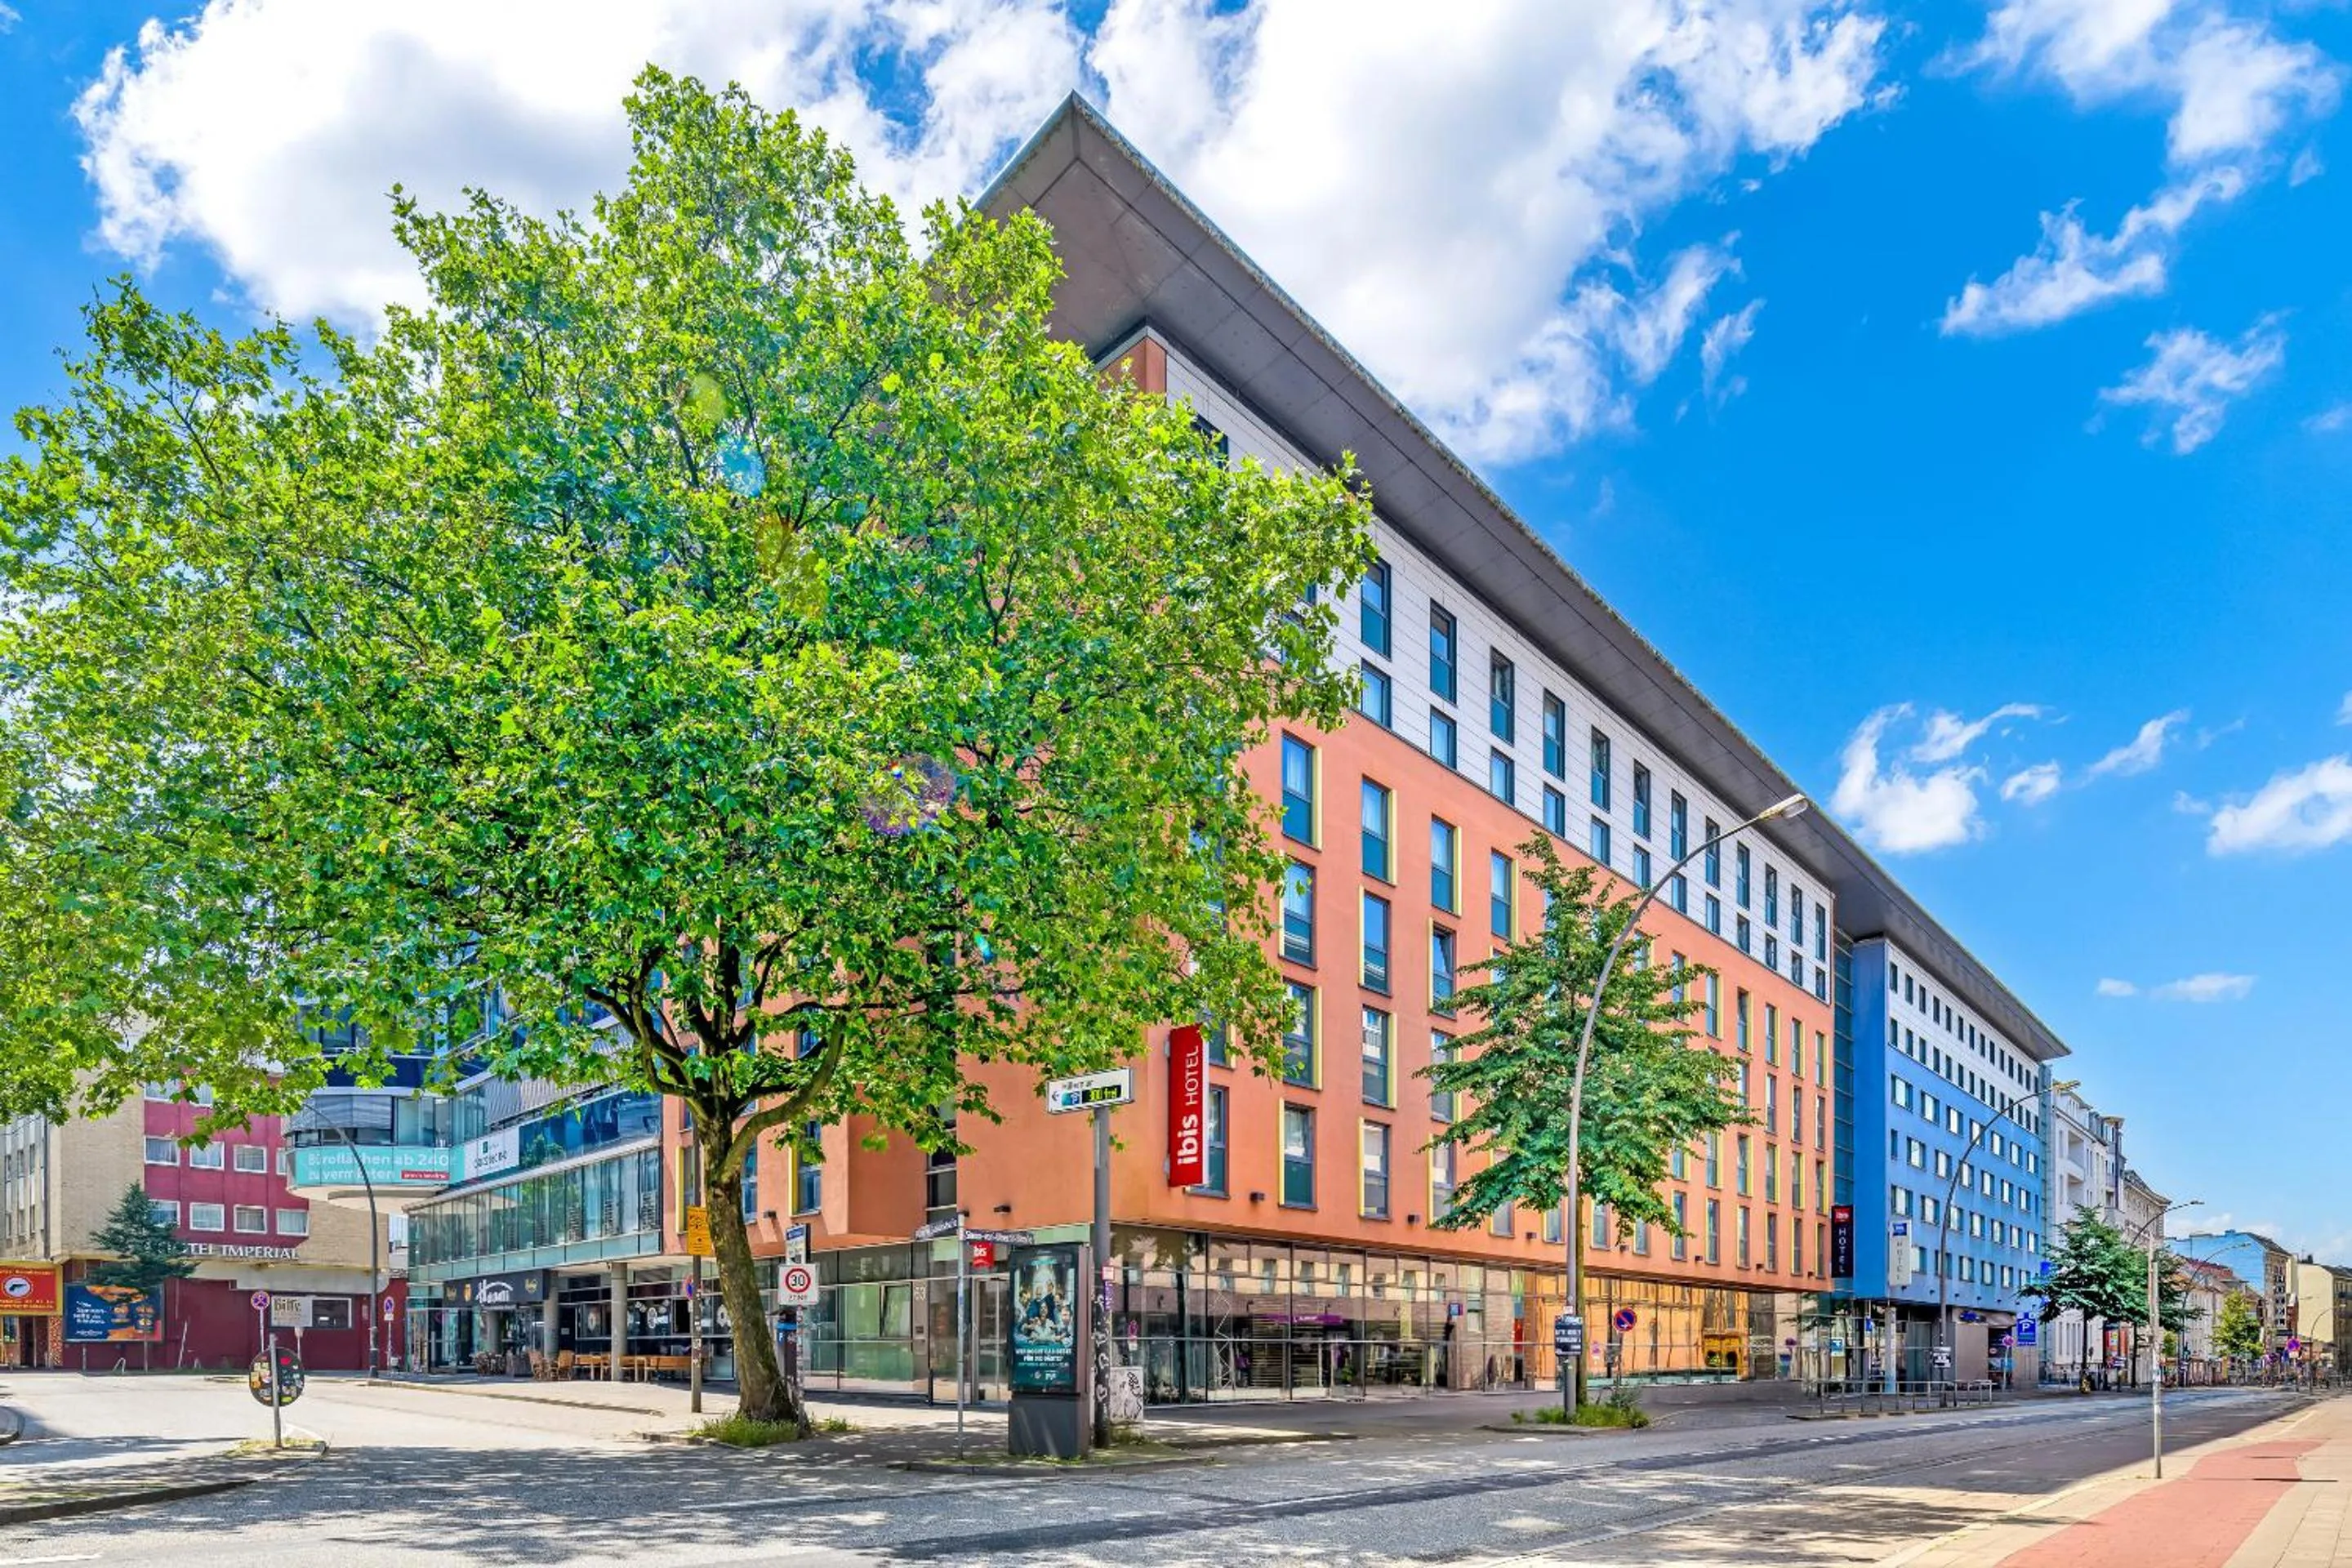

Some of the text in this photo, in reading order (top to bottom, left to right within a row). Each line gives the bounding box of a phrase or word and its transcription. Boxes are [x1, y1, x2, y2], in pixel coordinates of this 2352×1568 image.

[1177, 1045, 1200, 1165] ibis HOTEL
[394, 1153, 414, 1166] ab
[221, 1245, 300, 1259] IMPERIAL
[1838, 1227, 1846, 1273] HOTEL
[791, 1274, 805, 1286] 30
